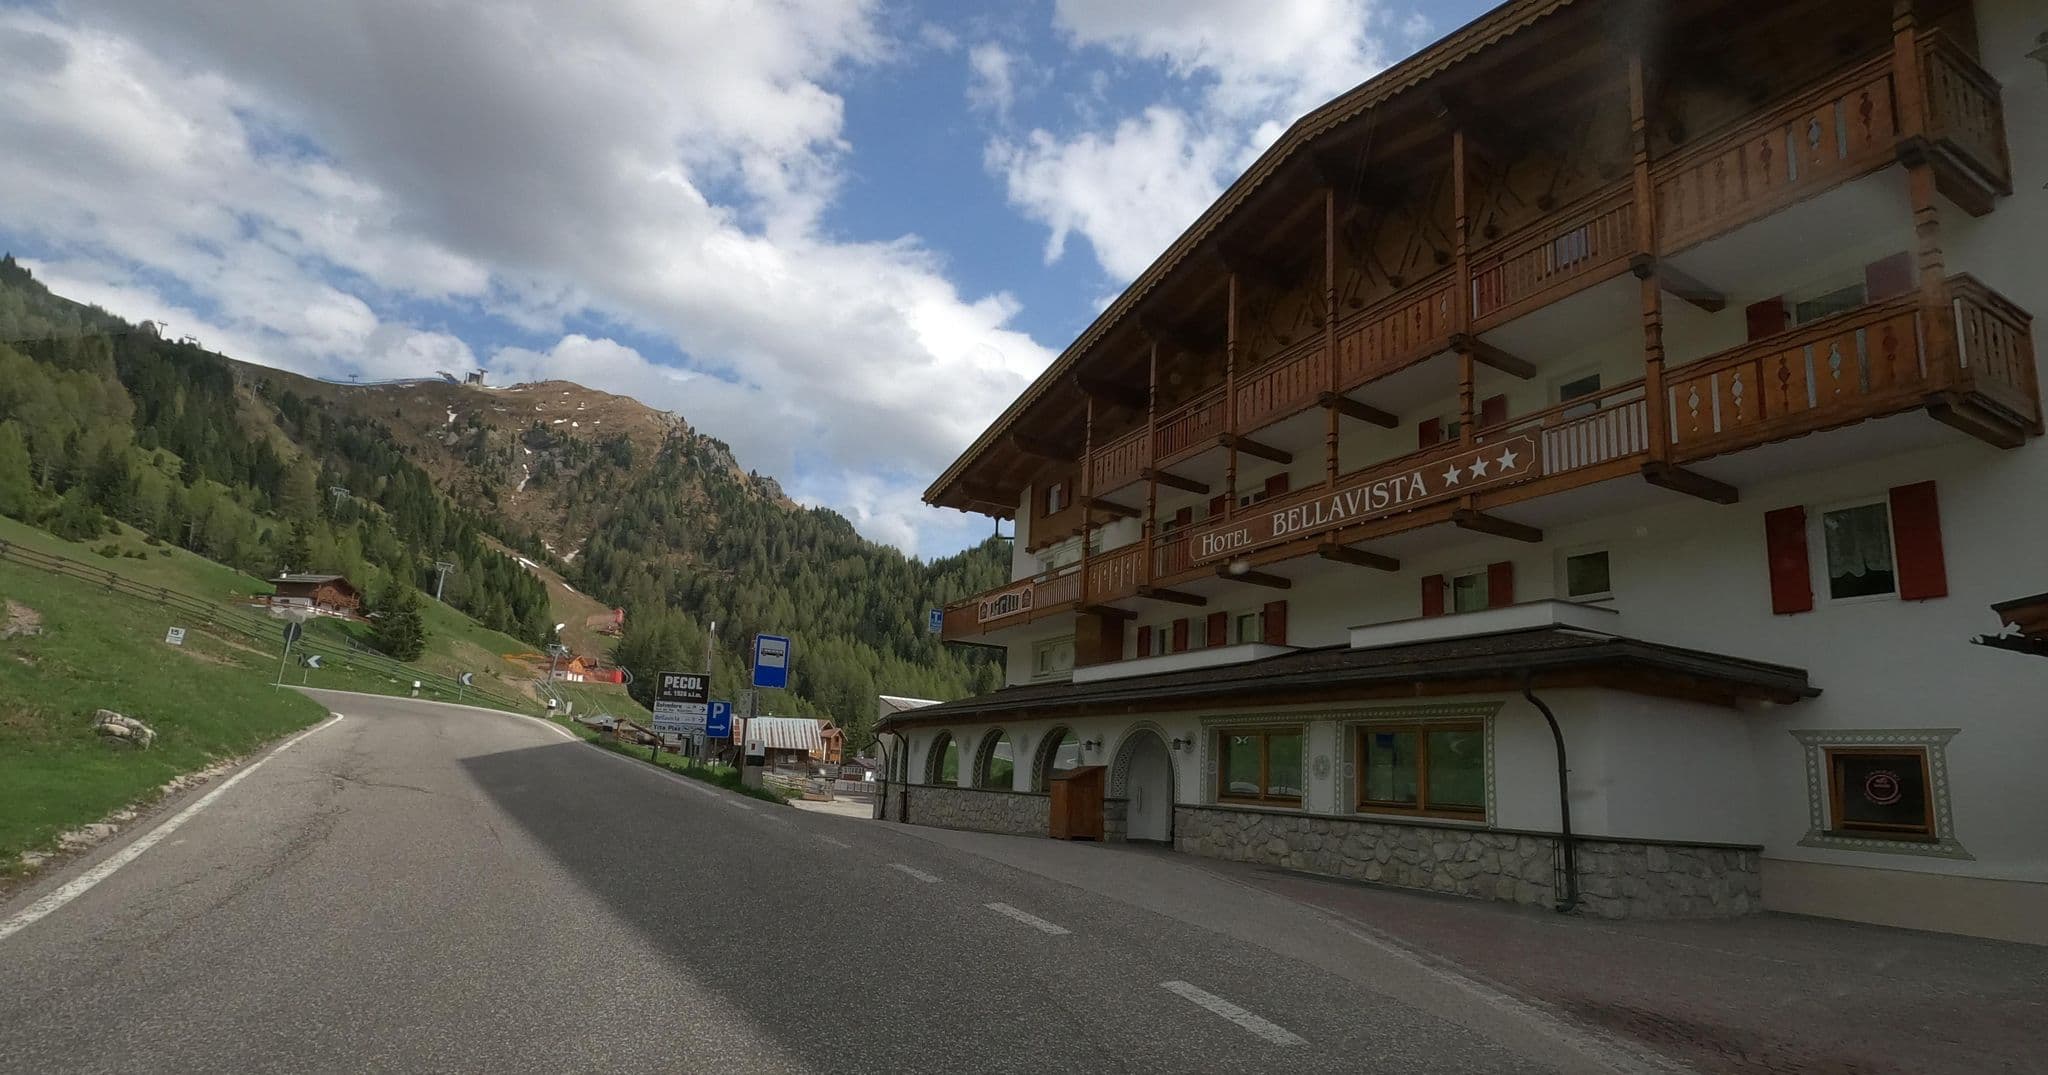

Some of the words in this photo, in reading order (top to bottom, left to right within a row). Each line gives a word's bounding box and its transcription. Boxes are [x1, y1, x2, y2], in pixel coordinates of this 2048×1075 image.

[1272, 472, 1428, 537] BELLAVISTA
[664, 676, 702, 689] PECOL
[712, 703, 724, 718] P
